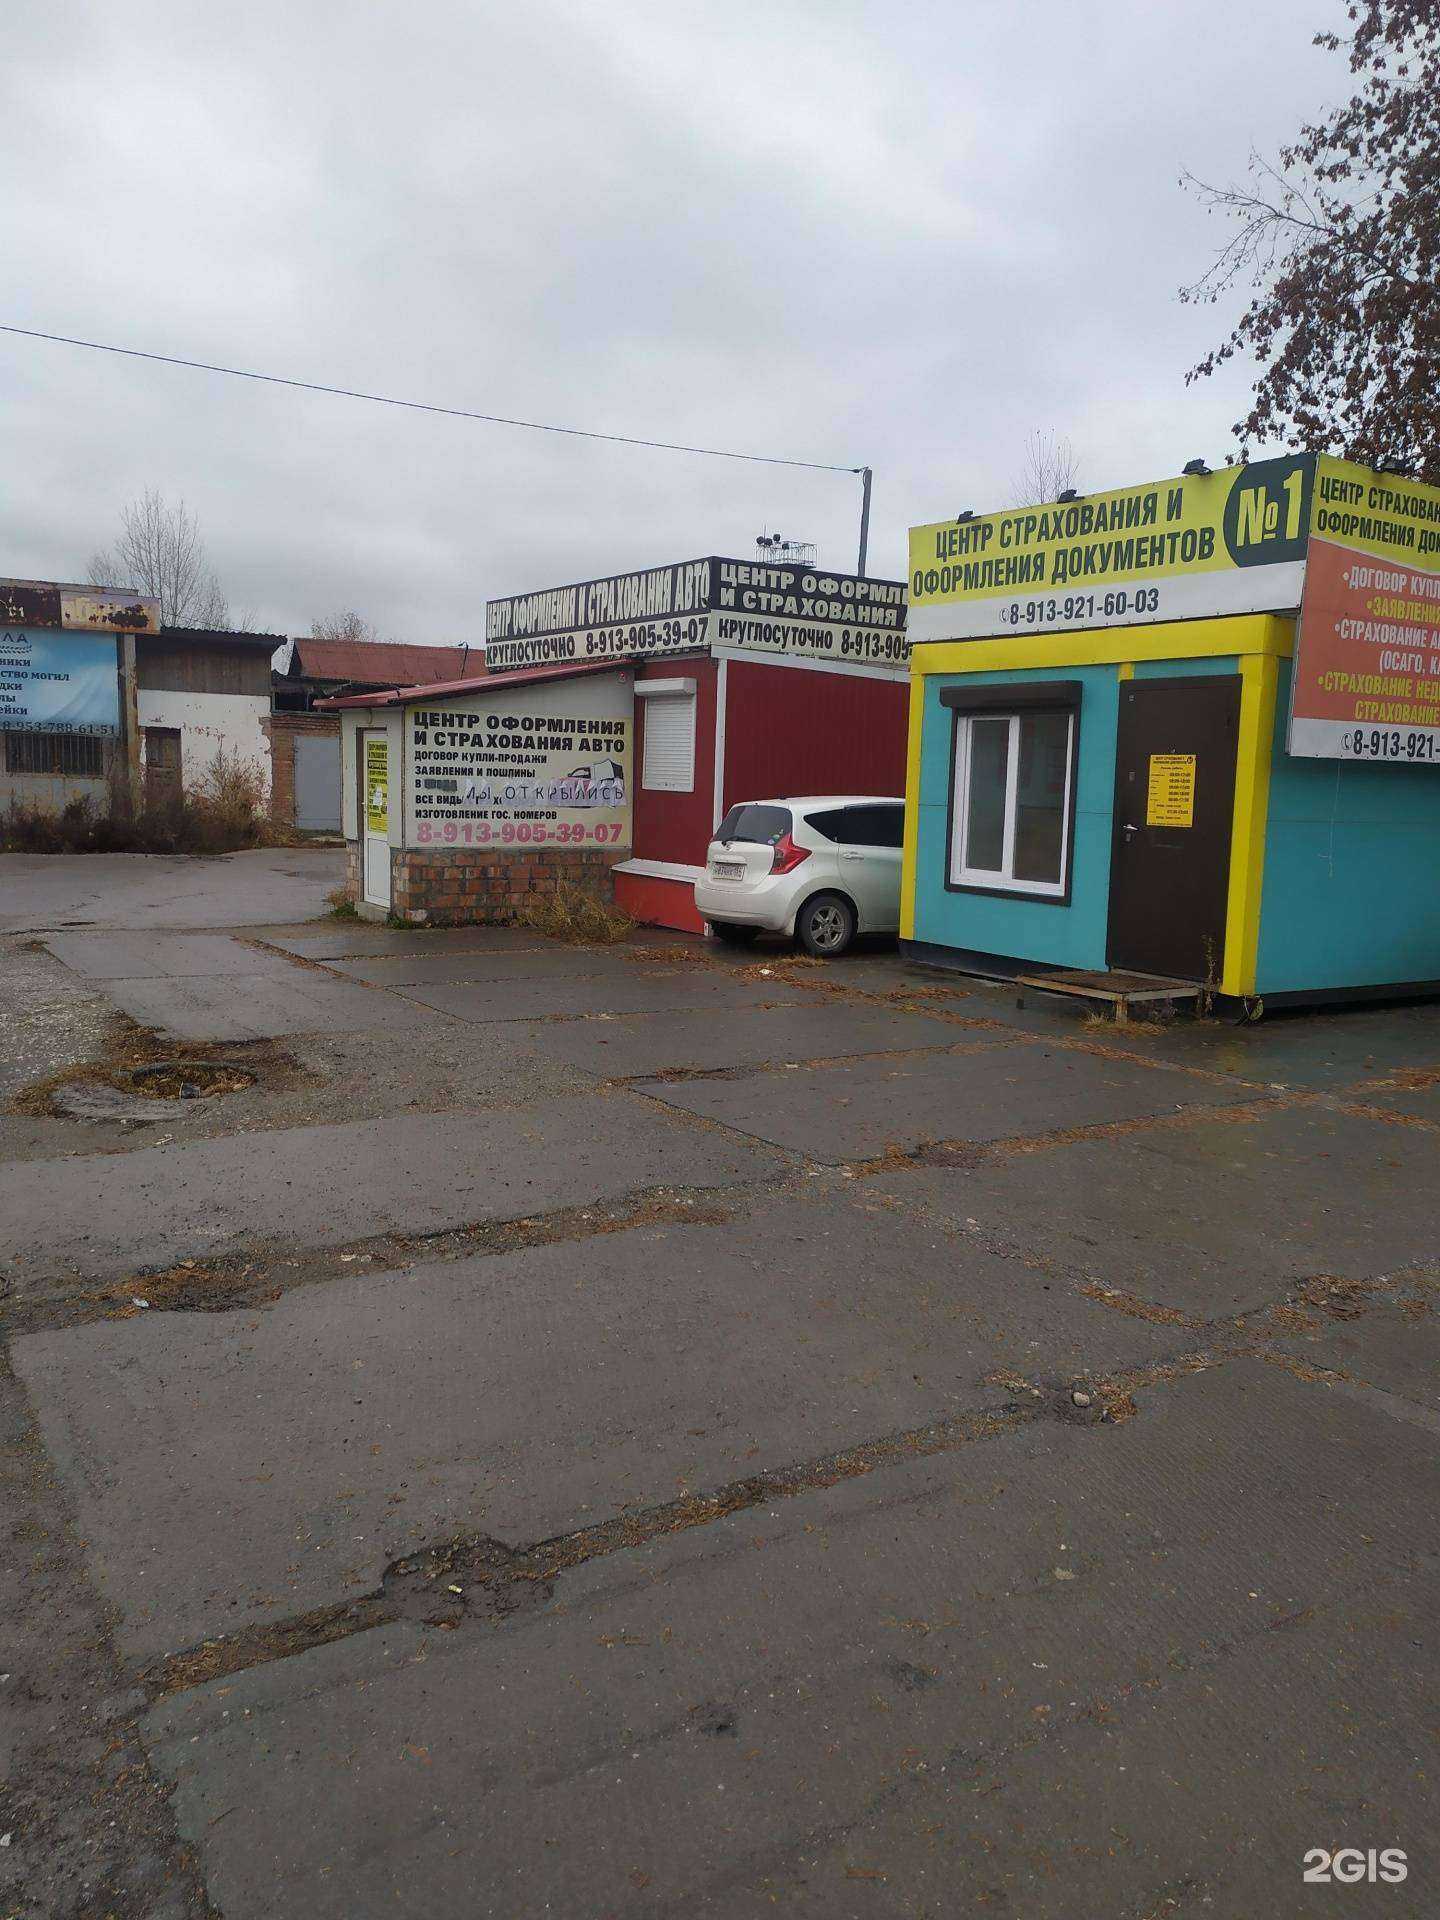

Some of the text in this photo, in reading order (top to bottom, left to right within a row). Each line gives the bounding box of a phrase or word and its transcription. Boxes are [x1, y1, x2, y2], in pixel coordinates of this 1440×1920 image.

[1320, 476, 1363, 505] ЦЕНТР
[936, 487, 1183, 562] ЦЕНТР СТРАХОВАНИЯ И
[1317, 508, 1415, 548] ОФОРМЛЕНИЯ
[913, 526, 1215, 598] ОФОРМЛЕНИЯ ДОКУМЕНТОВ
[720, 563, 795, 590] ЦЕНТР
[1349, 565, 1406, 592] ДОГОВОР
[488, 560, 710, 641] ЦЕНТР ОФОРМЛЕНИЯ И СТРАХОВАНИЯ АВТО
[720, 587, 735, 607] И
[742, 590, 898, 628] СТРАХОВАНИЯ
[1009, 588, 1159, 625] 8-913-921-60-03
[486, 616, 709, 665] КРУГЛОСУТОЧНО 8-913-905-39-07
[718, 617, 834, 650] КРУГЛОСУТОЧНО
[1340, 618, 1427, 648] СТРАХОВАНИЕ
[31, 672, 70, 682] могил
[1324, 671, 1412, 698] СТРАХОВАНИЕ
[414, 711, 625, 736] ЦЕНТР ОФОРМЛЕНИЯ
[414, 730, 625, 753] И СТРАХОВАНИЯ АВТО
[414, 750, 548, 765] ДОГОВОР КУПЛИ-ПРОДАЖИ
[415, 766, 536, 779] ЗАЯВЛЕНИЯ И ПОШЛИНЫ
[415, 794, 434, 805] ВСЕ
[415, 809, 557, 820] ИЗГОТОВЛЕНИЕ ГОС. НОМЕРОВ
[417, 822, 623, 843] 8-913-905-39-07
